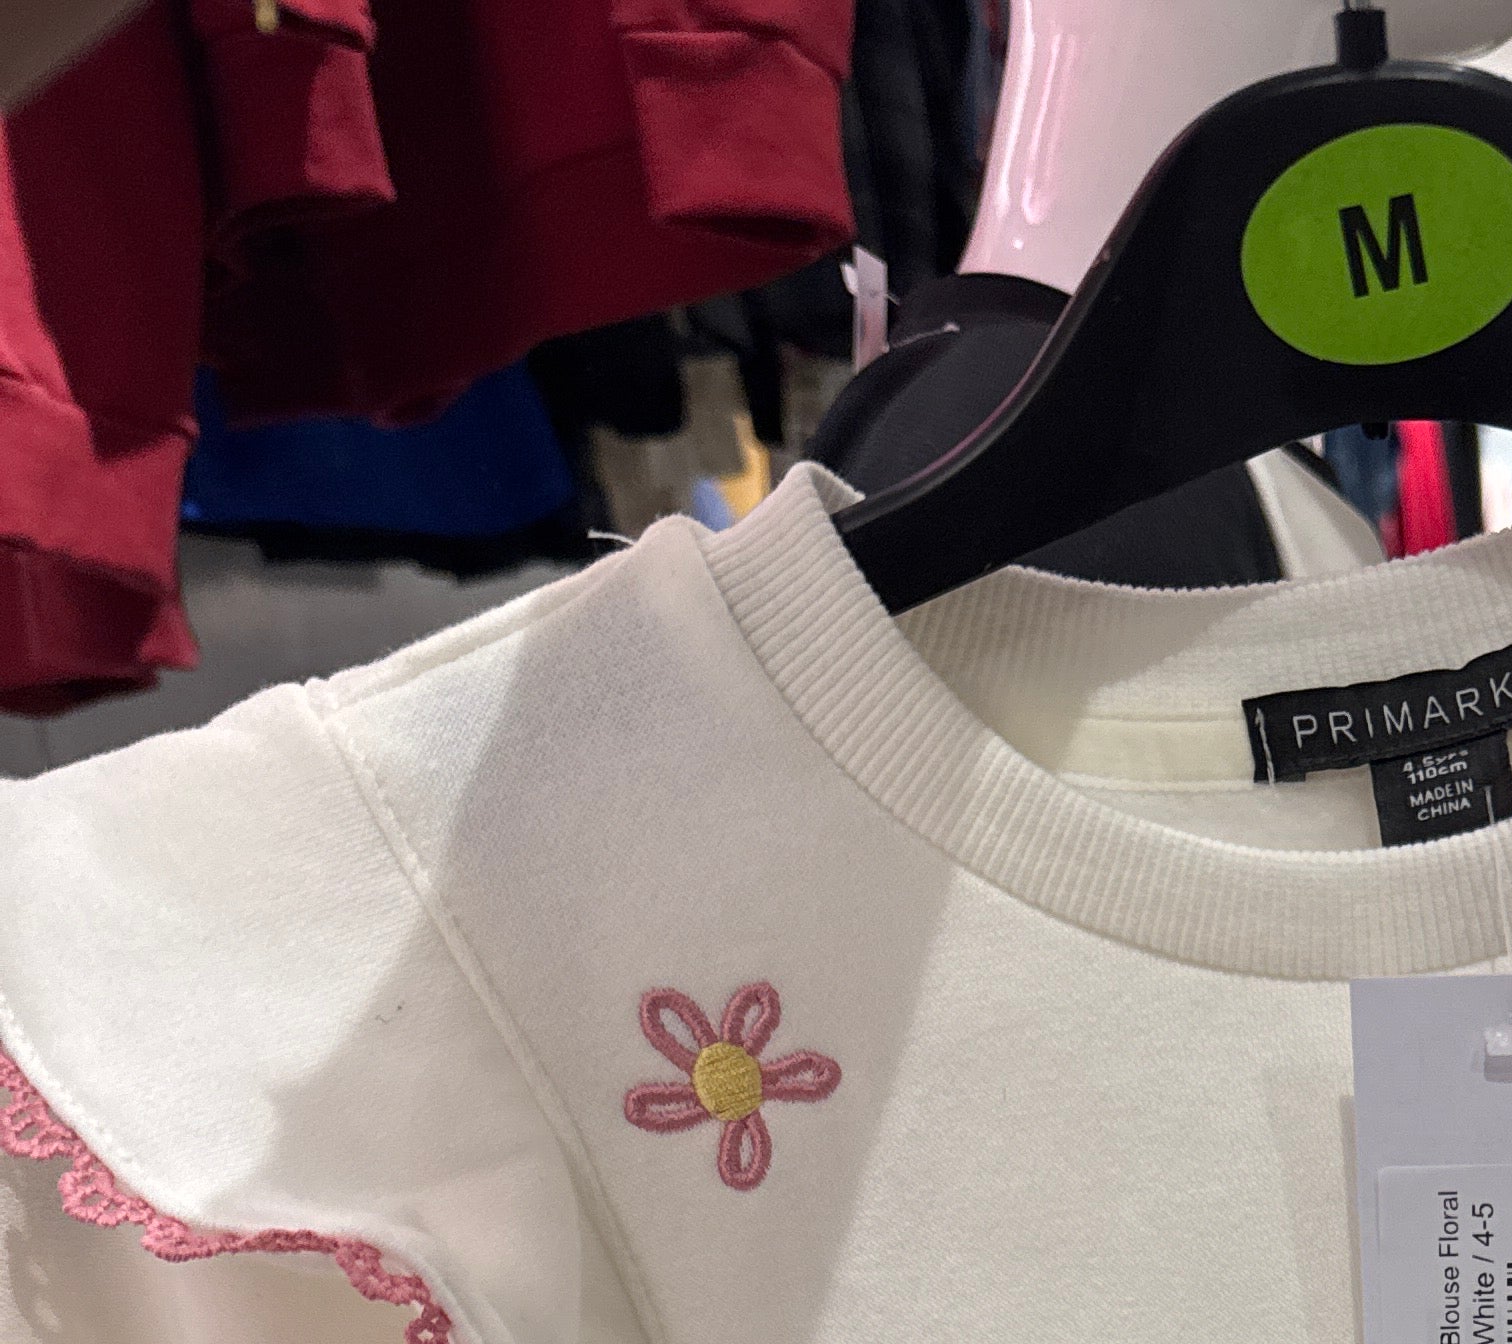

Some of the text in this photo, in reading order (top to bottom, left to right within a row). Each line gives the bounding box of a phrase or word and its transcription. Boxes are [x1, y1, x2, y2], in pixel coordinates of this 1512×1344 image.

[1338, 193, 1429, 298] M
[1402, 750, 1469, 773] 45yr
[1407, 760, 1468, 785] 110cm
[1409, 777, 1474, 808] MADE IN
[1417, 797, 1472, 821] CHINA
[1437, 1190, 1459, 1258] Floral
[1471, 1202, 1495, 1247] 4-5
